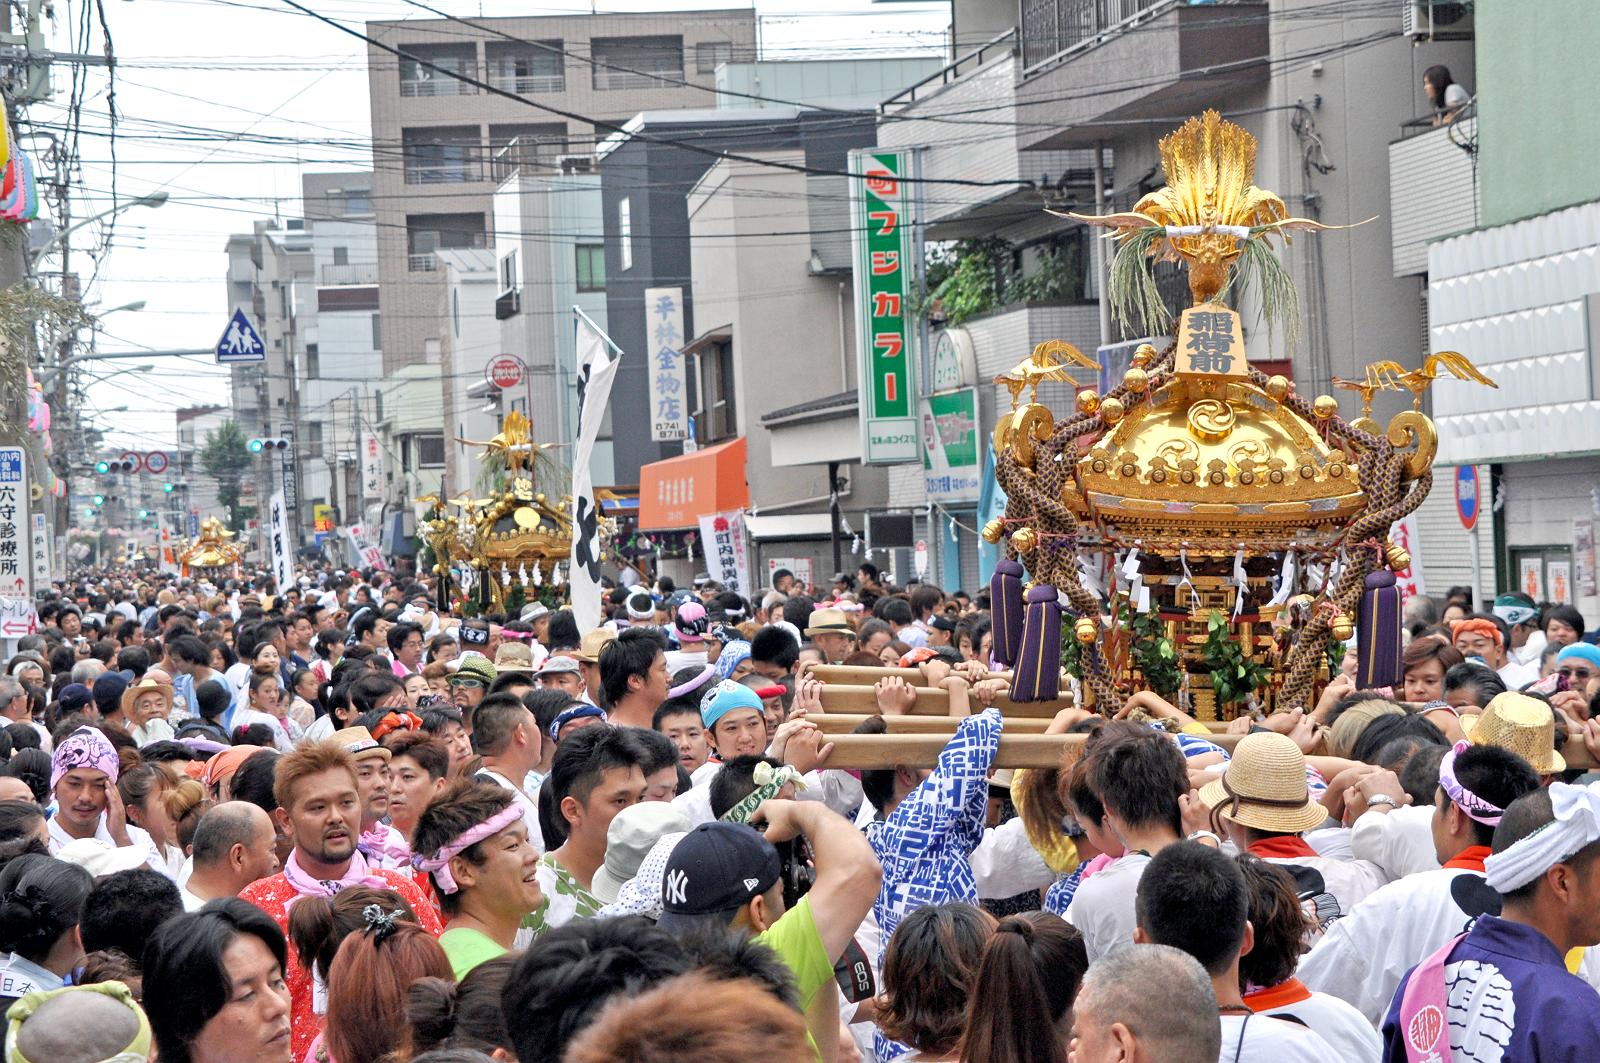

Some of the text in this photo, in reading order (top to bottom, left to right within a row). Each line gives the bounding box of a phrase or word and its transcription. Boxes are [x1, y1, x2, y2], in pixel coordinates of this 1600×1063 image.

[868, 211, 903, 402] フジカラー
[654, 295, 681, 421] 平林金物店
[0, 486, 18, 575] 穴守診療所
[34, 535, 46, 574] かみや
[666, 869, 688, 904] NY
[854, 961, 870, 992] EOS
